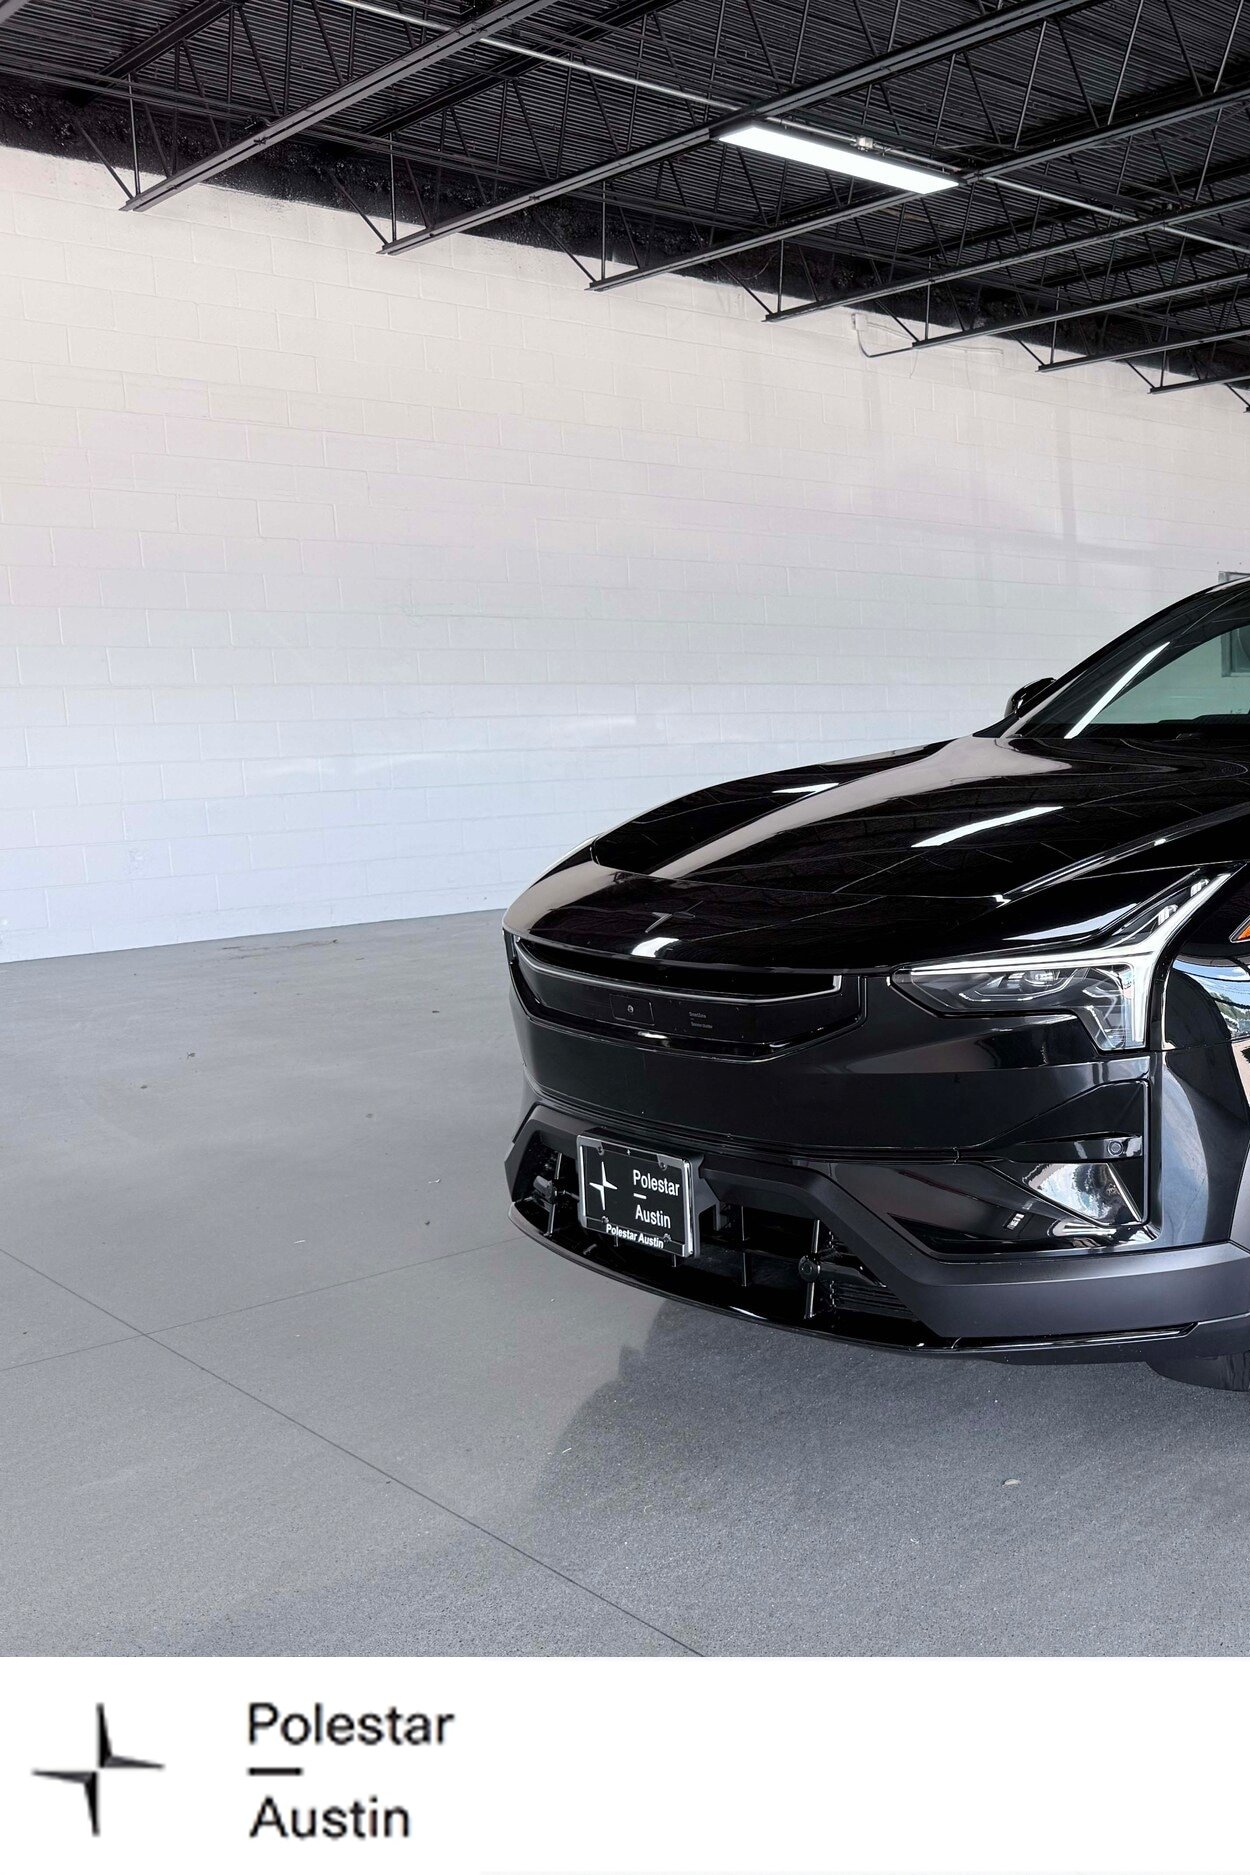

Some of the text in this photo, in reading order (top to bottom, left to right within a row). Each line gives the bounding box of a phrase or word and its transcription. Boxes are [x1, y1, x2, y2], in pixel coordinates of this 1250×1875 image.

[633, 1169, 680, 1197] Polestar
[635, 1204, 671, 1229] Austin
[606, 1223, 664, 1249] Polestar Austin
